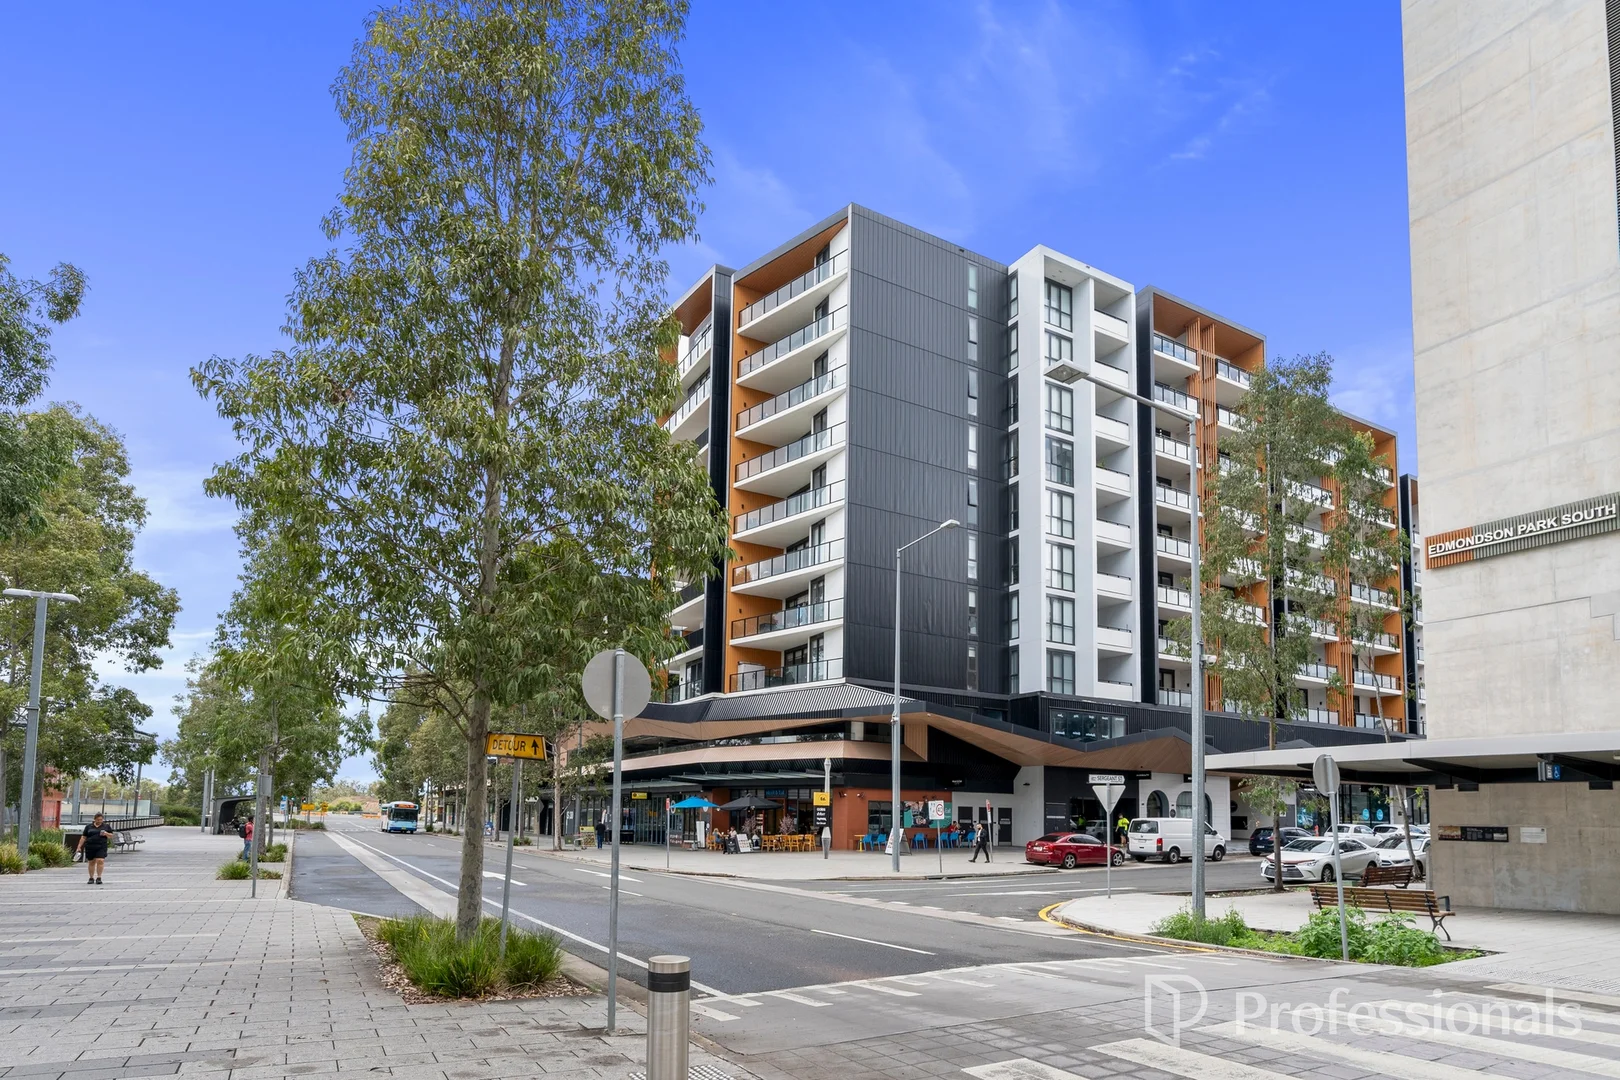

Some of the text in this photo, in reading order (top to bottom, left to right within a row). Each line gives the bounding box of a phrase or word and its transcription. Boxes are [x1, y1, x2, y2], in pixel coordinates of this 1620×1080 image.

[1428, 503, 1616, 555] EDMONDSON PARK SOUTH
[492, 739, 526, 752] DETOUR
